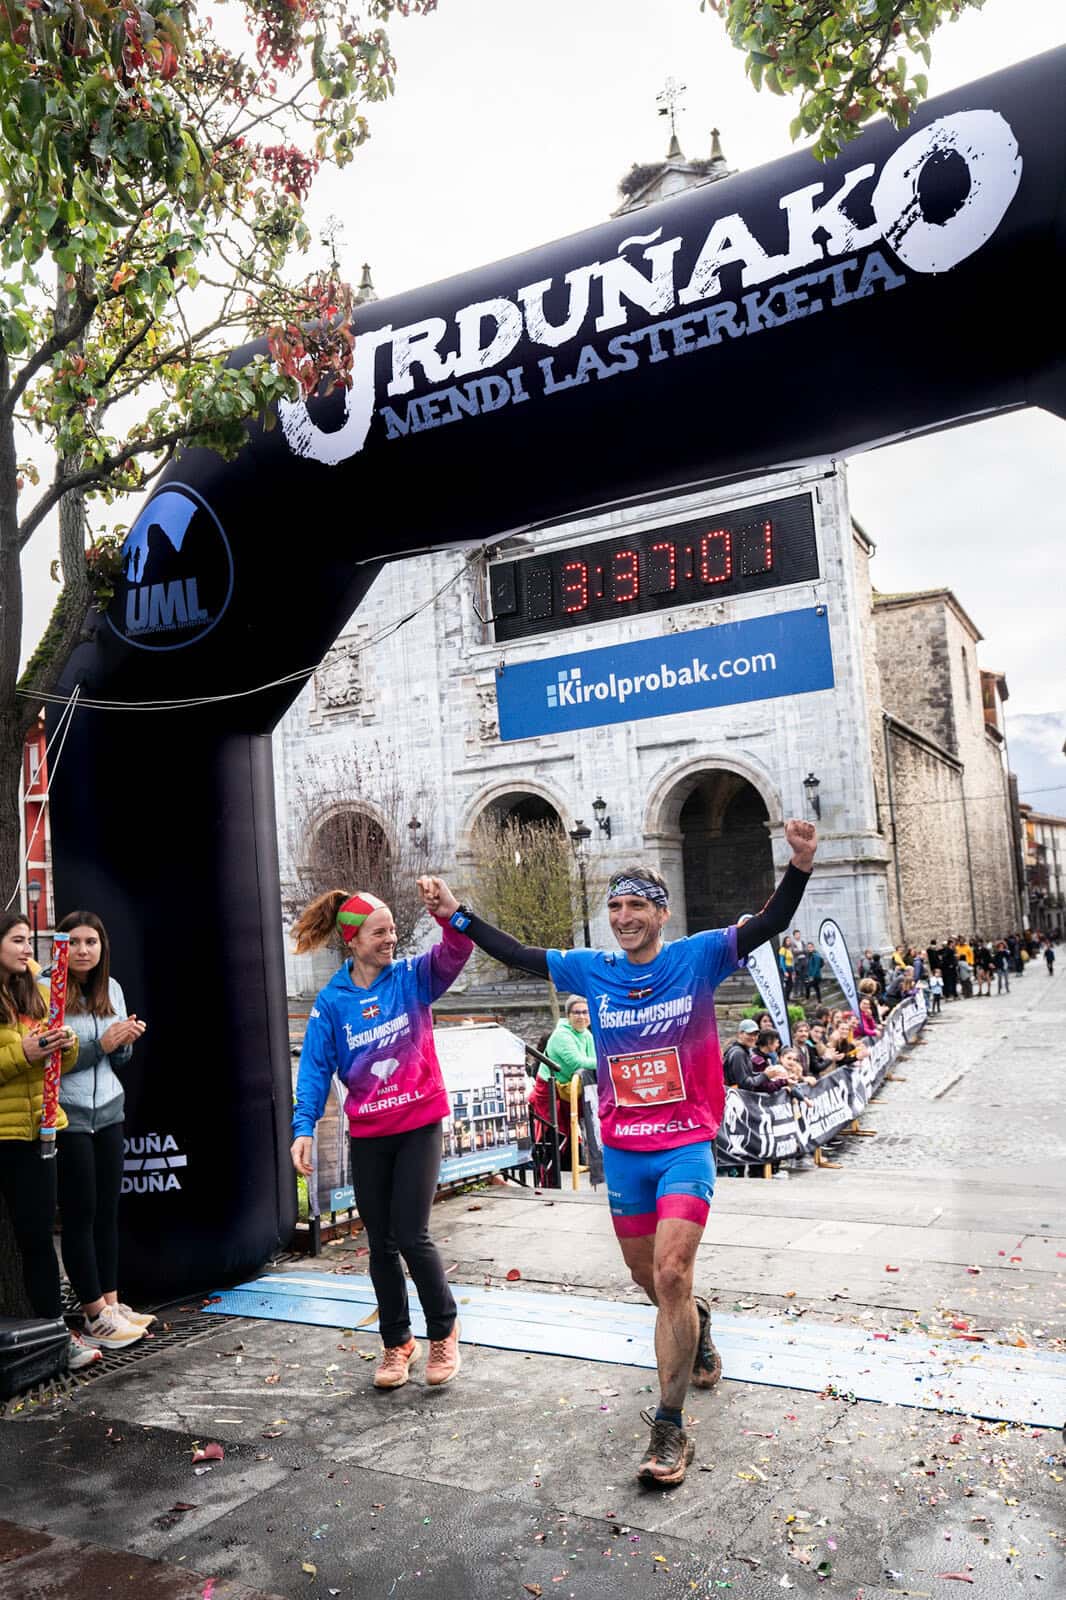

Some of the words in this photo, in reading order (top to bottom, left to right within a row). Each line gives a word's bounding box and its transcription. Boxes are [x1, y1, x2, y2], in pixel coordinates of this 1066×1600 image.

[273, 108, 1023, 466] URDUÑAKO
[379, 366, 530, 440] MENDI
[537, 250, 906, 396] LASTERKETA
[565, 519, 773, 613] 3:37:01
[126, 577, 208, 632] UML
[558, 650, 777, 707] Kirolprobak.com
[620, 1060, 667, 1079] 312B
[358, 1090, 424, 1115] MERRELL
[615, 1117, 701, 1136] MERRELL
